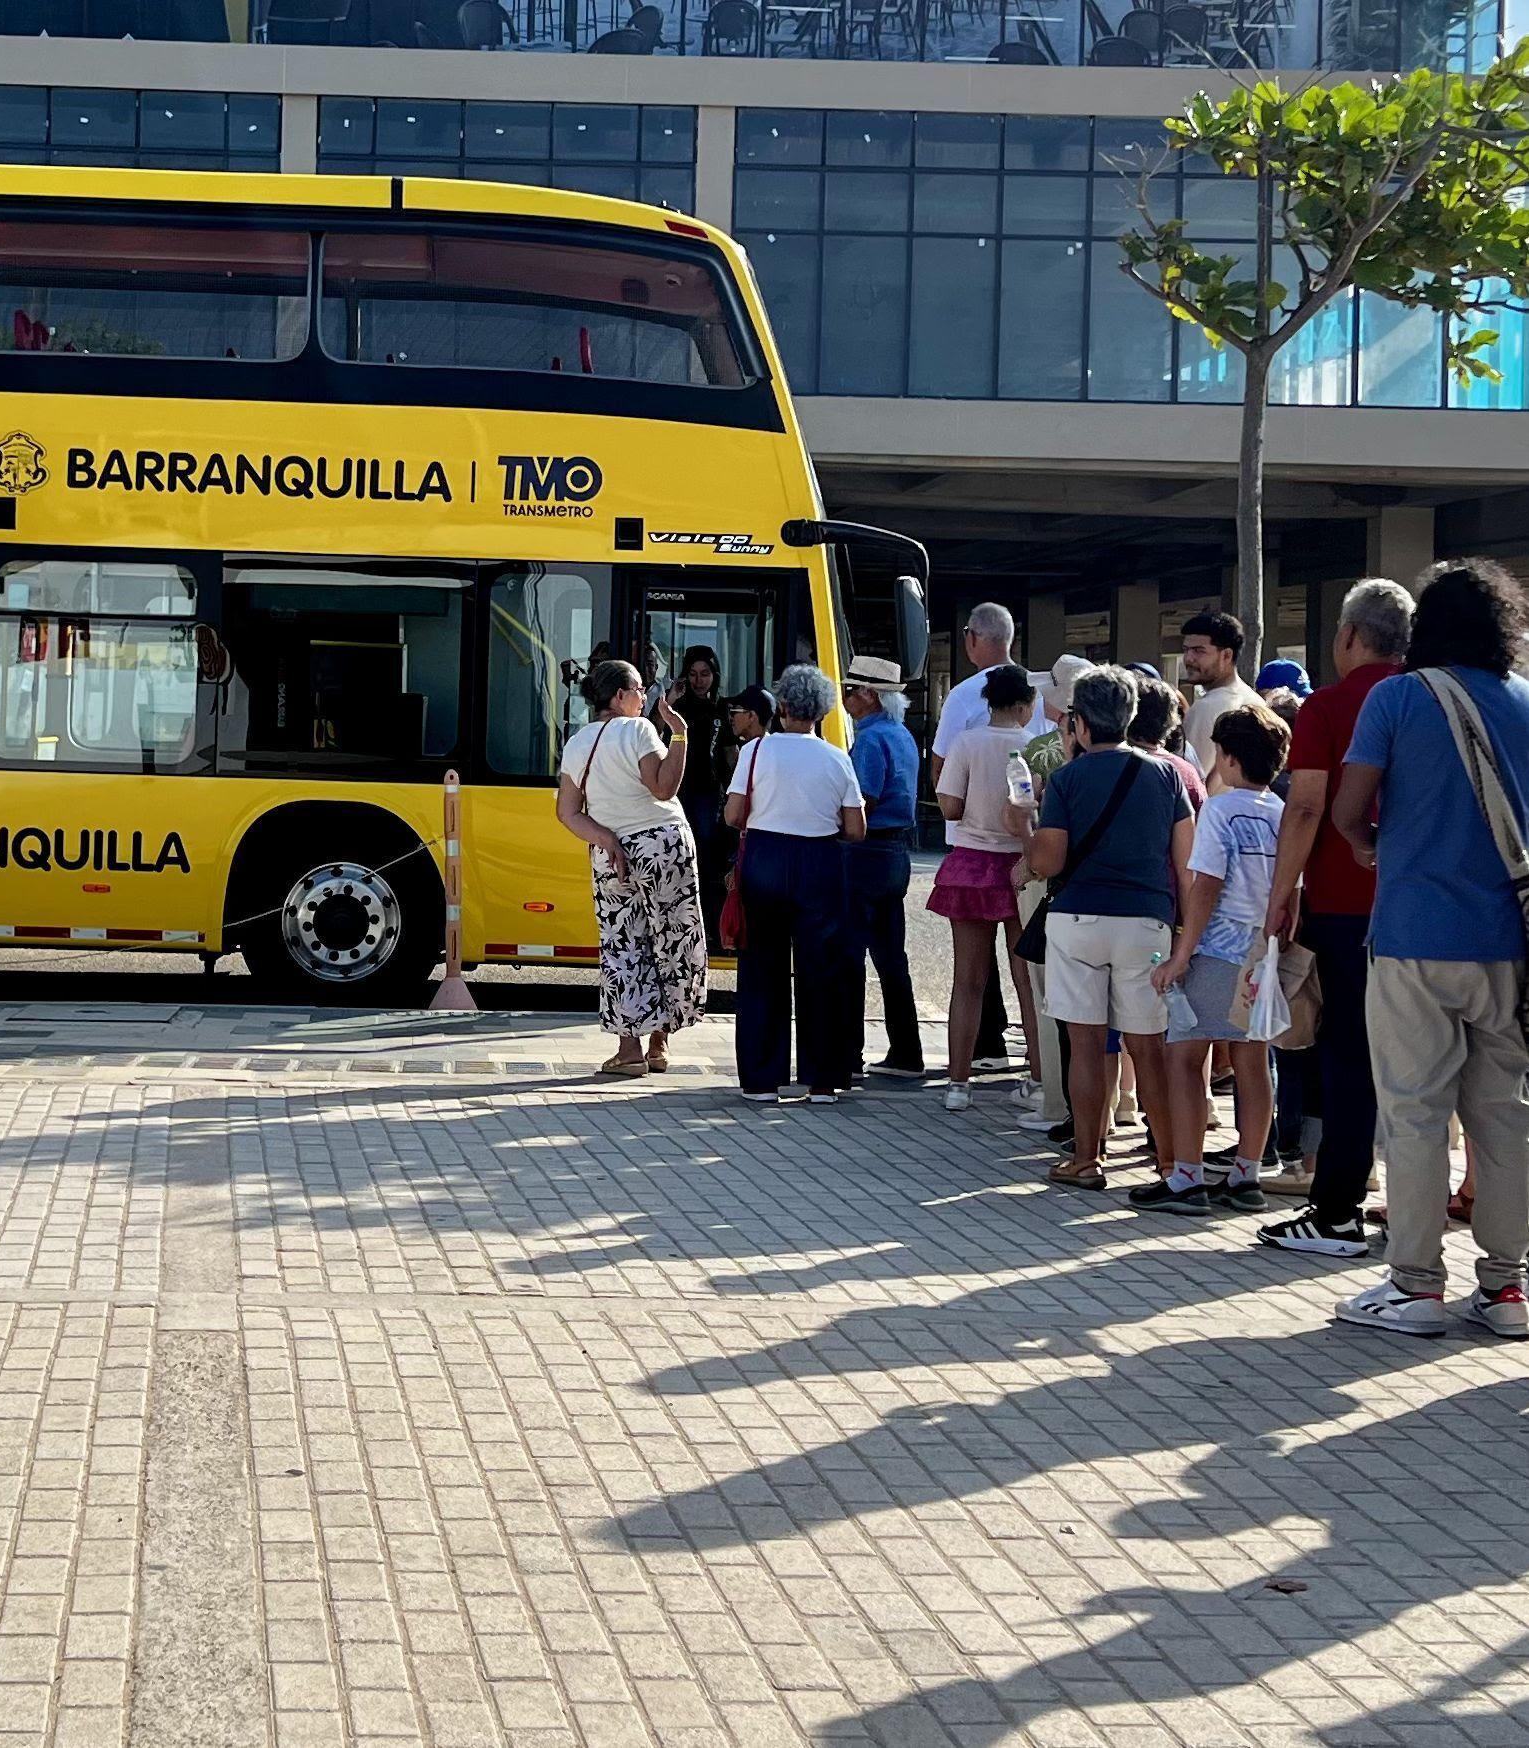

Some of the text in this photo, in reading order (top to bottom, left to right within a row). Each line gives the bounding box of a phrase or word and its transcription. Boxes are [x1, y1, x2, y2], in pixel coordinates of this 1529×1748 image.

[66, 447, 452, 503] BARRANQUILLA
[497, 455, 603, 502] TMO
[718, 543, 770, 554] Sunny
